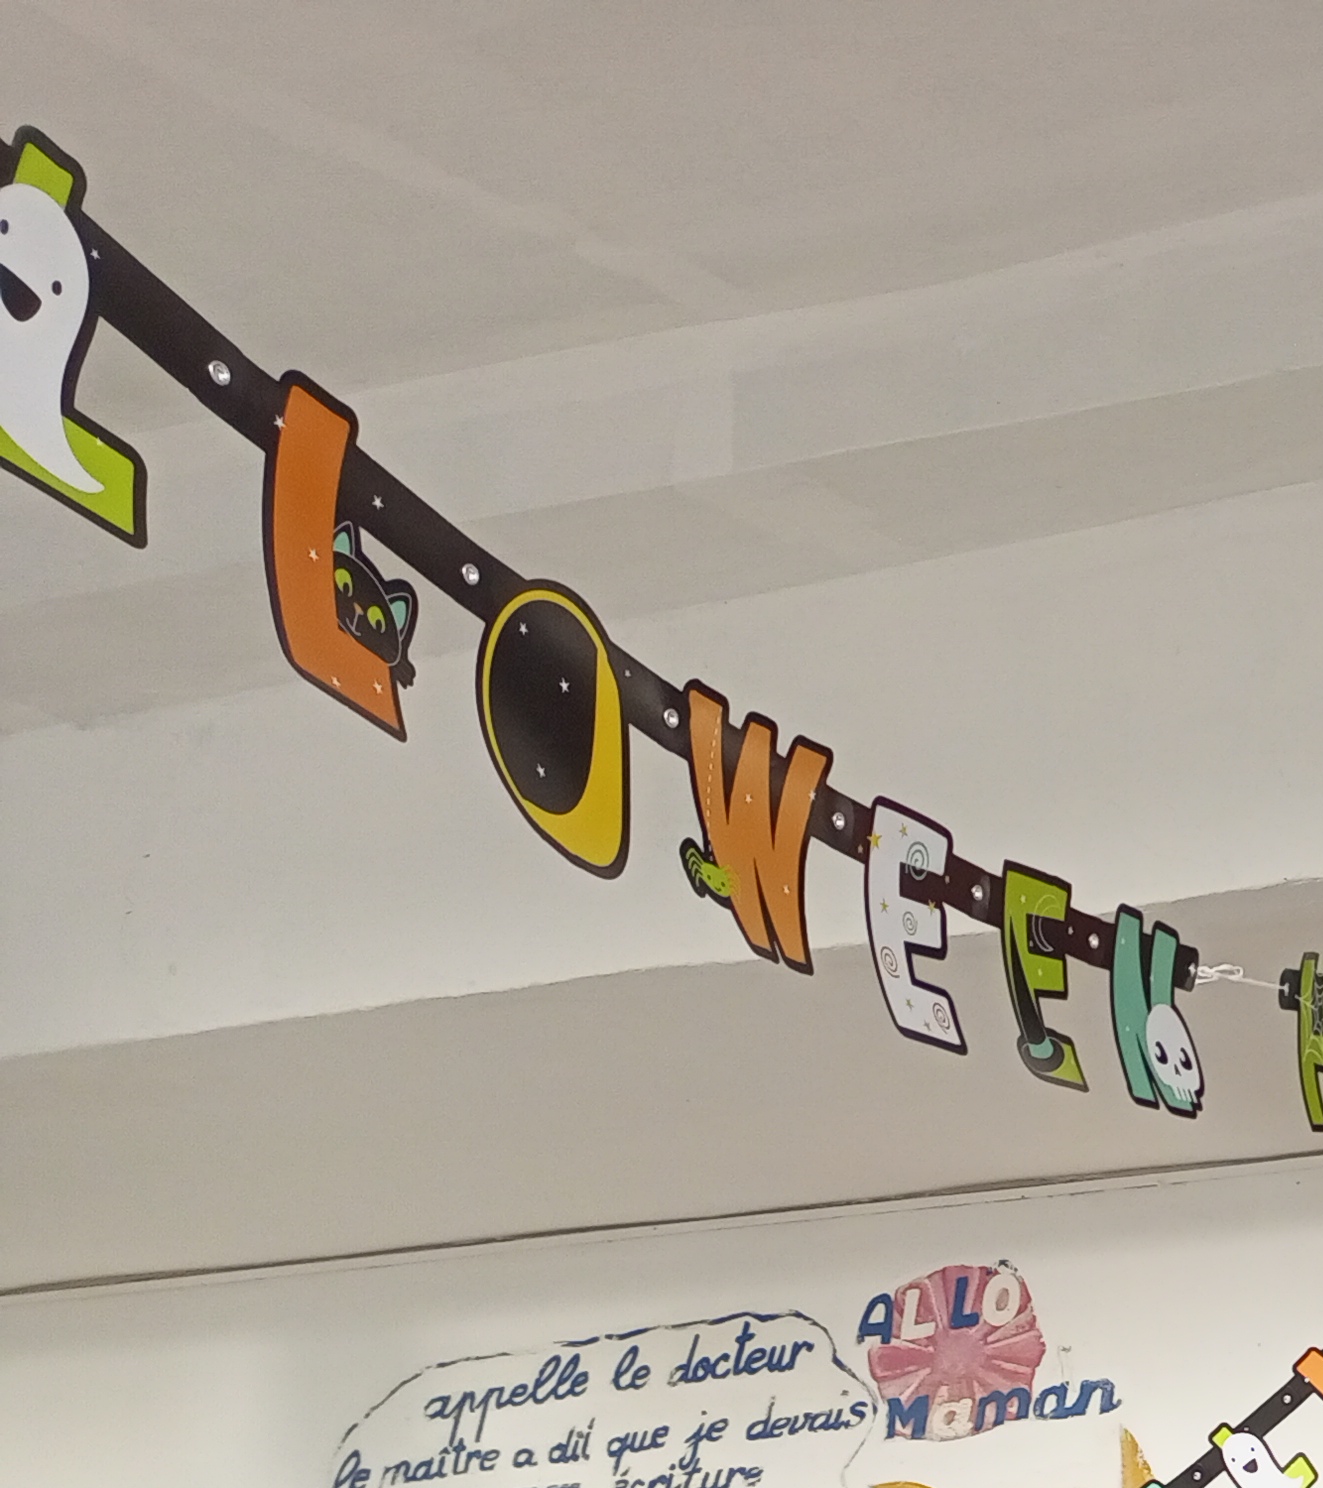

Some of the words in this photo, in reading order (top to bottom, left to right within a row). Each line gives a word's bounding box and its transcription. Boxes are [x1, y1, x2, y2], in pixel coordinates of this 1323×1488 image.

[379, 1438, 500, 1488] maître
[512, 1448, 538, 1468] a
[606, 1425, 670, 1476] que
[680, 1410, 729, 1470] je
[746, 1391, 868, 1441] devais
[424, 1353, 589, 1447] appelle
[611, 1345, 651, 1390] le
[667, 1321, 815, 1387] docteur
